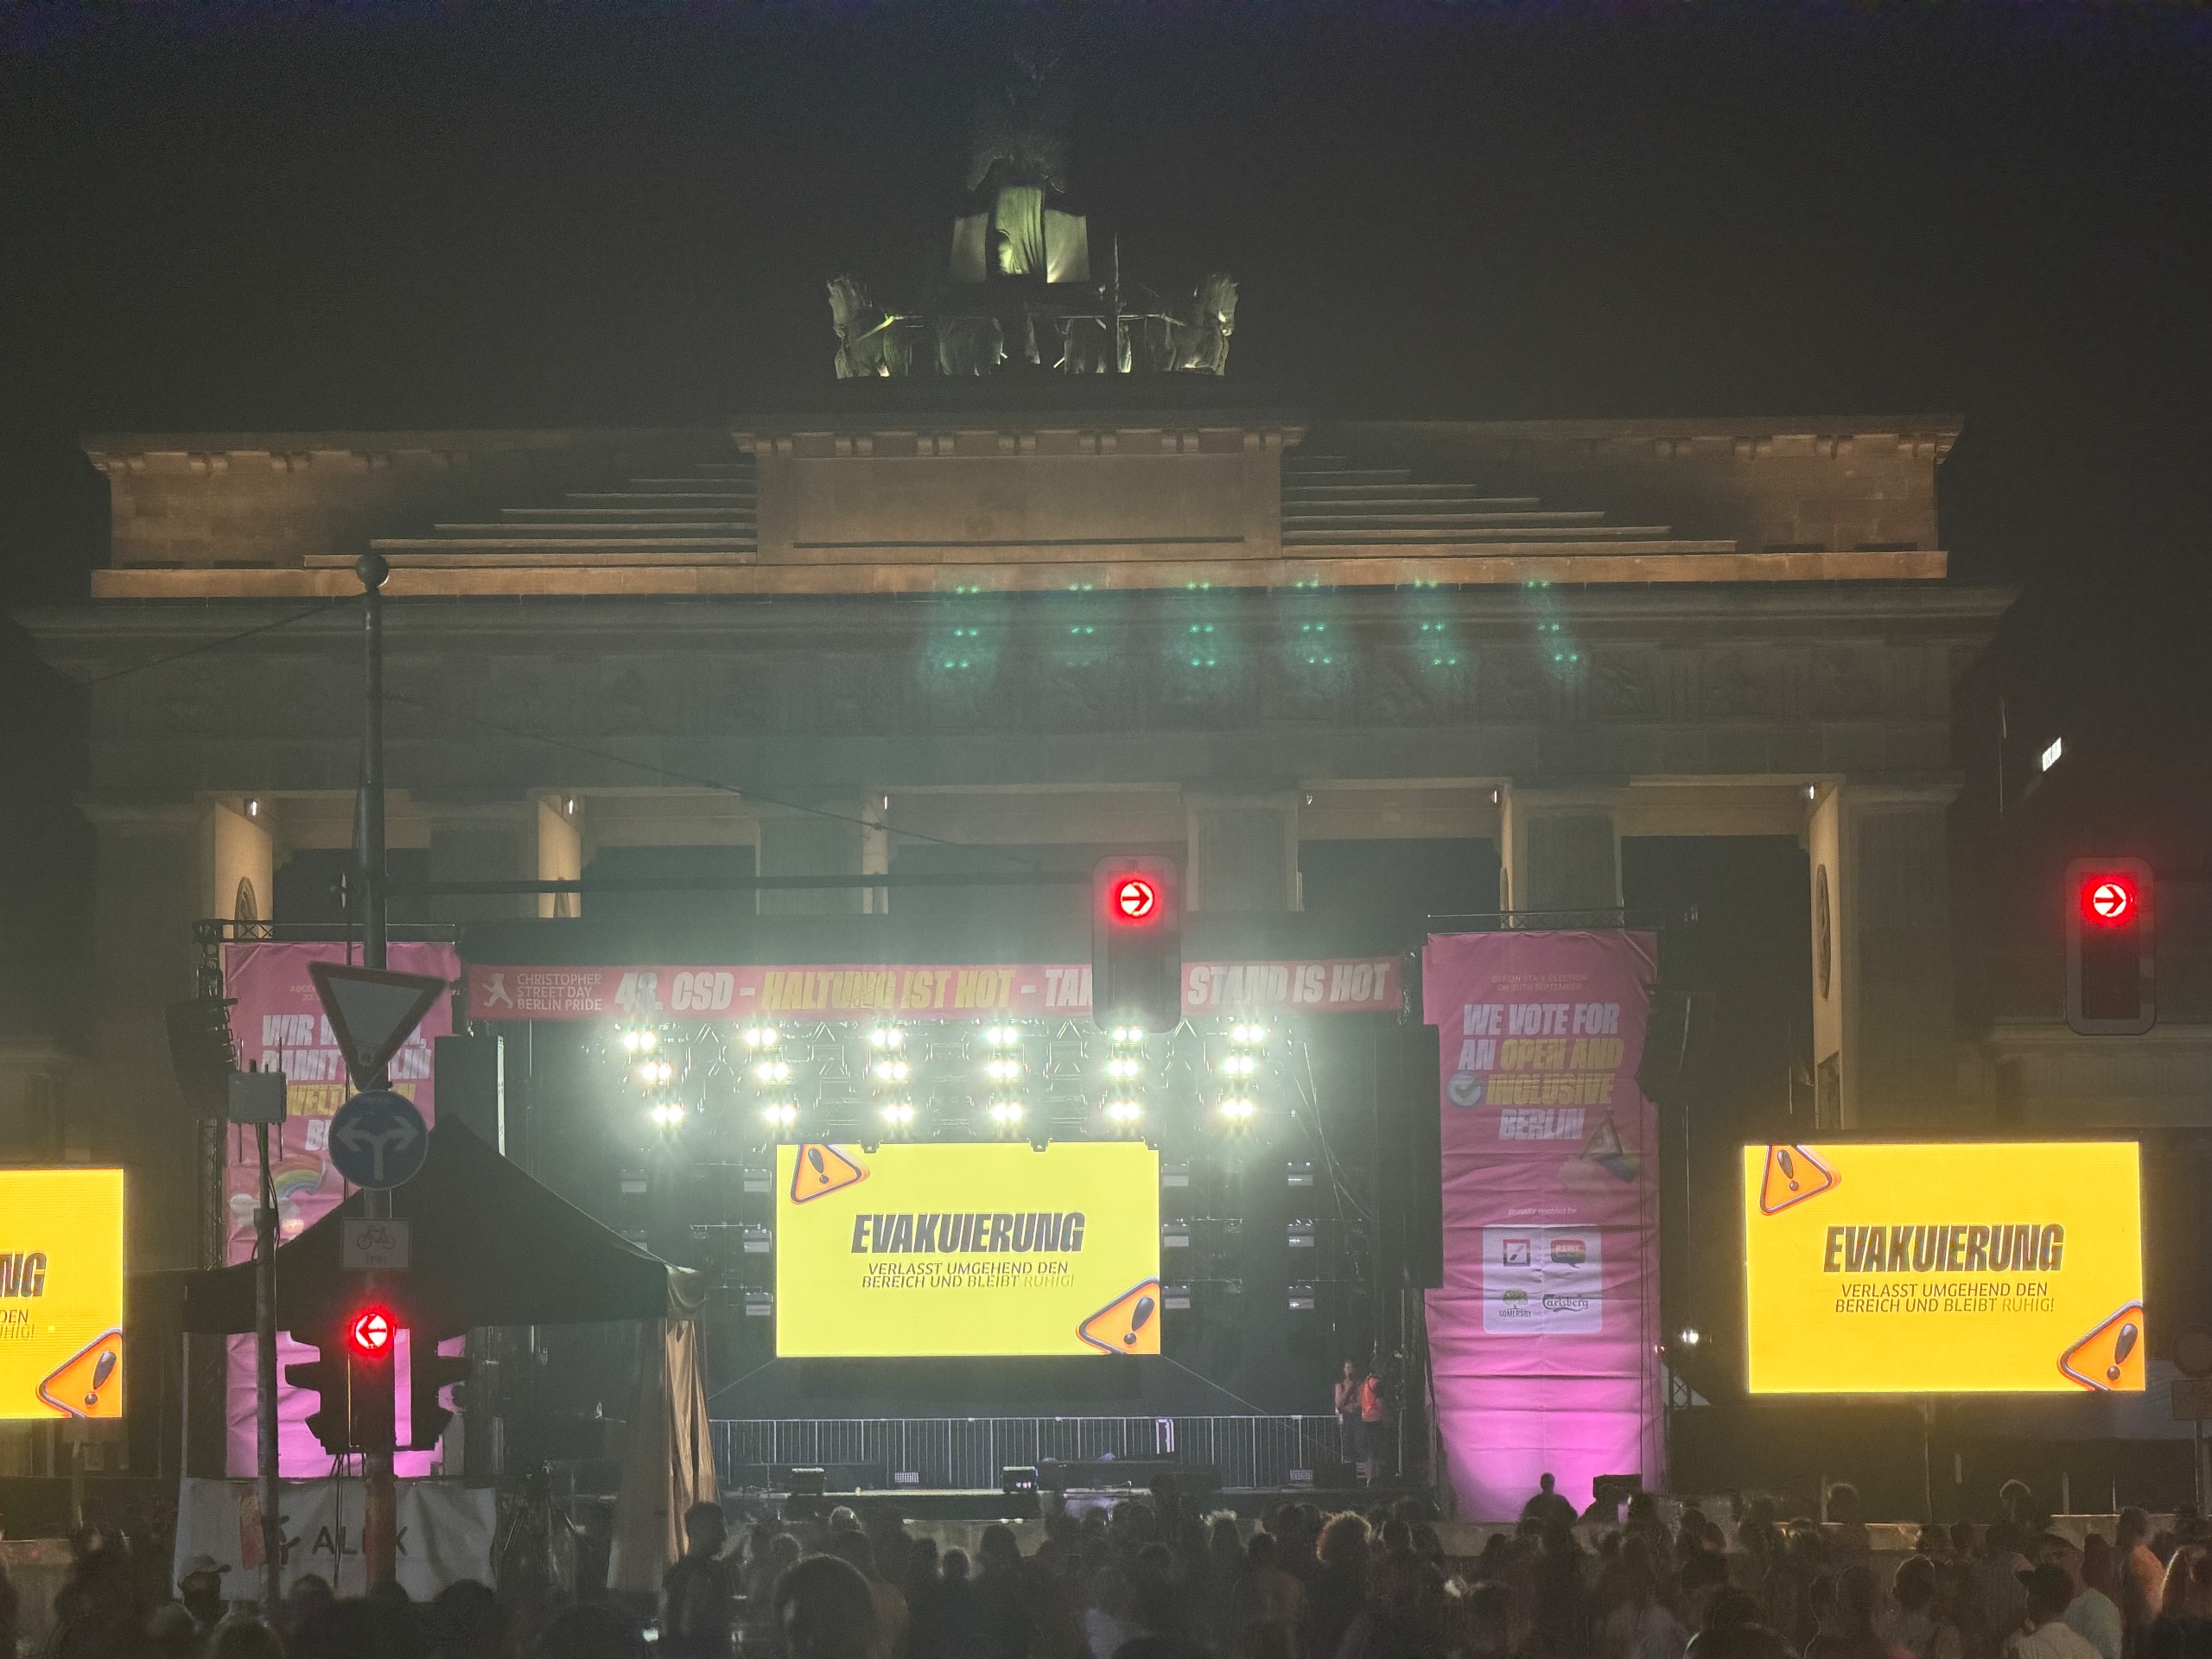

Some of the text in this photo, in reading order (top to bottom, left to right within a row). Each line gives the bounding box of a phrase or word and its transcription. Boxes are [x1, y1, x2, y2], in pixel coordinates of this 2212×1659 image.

[517, 973, 602, 985] CHRISTOPHER
[671, 971, 734, 1011] CSD
[761, 970, 897, 1010] HALTUNG
[900, 970, 950, 1009] IST
[954, 969, 1015, 1008] HOT
[1186, 965, 1288, 1005] STAND
[1292, 964, 1325, 1004] IS
[1329, 963, 1391, 1002] HOT
[517, 986, 593, 998] STREET DAY
[518, 998, 602, 1011] BERLIN PRIDE
[1464, 1002, 1620, 1035] WE VOTE FOR
[262, 1014, 315, 1046] WIR
[1458, 1038, 1624, 1071] AN OPEN AND
[1485, 1072, 1615, 1105] INCLUSIVE
[1498, 1108, 1586, 1140] BERLIN
[1567, 1207, 1578, 1216] by
[851, 1211, 1085, 1254] EVAKUIERUNG
[1823, 1224, 2065, 1273] EVAKUIERUNG
[868, 1261, 1069, 1275] VERLASST UMGEHEND DEN
[861, 1274, 1075, 1288] BEREICH UND BLEIBT RUHIG!
[1841, 1281, 2048, 1298] VERLASST UMGEHEND DEN
[1542, 1294, 1588, 1312] Carlsberg
[1835, 1297, 2055, 1313] BEREICH UND BLEIBT RUHIG!
[1498, 1309, 1531, 1318] SOMERSBY
